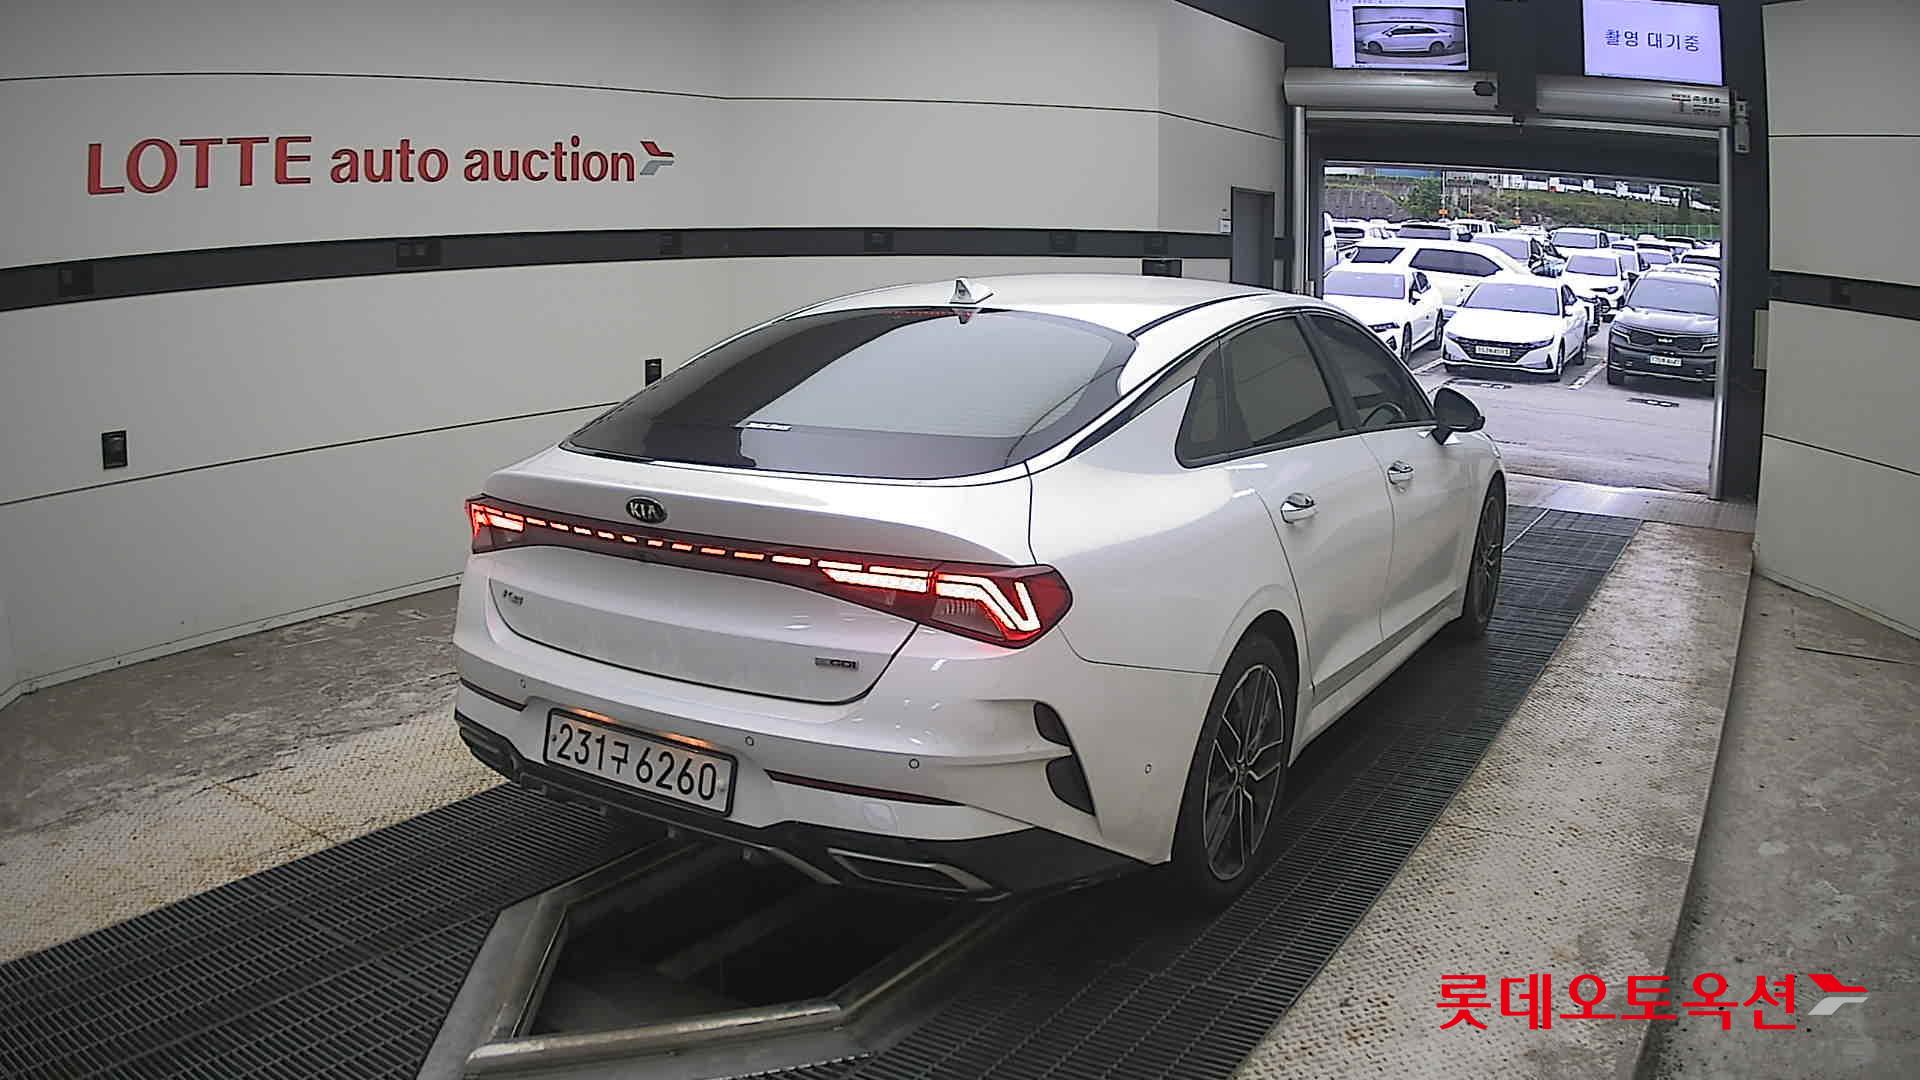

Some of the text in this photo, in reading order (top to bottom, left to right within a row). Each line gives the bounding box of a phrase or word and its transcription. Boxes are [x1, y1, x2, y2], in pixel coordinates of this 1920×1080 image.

[1604, 29, 1700, 52] 촬영 대기중
[87, 135, 636, 195] LOTTE auto auction
[630, 501, 660, 519] KIA
